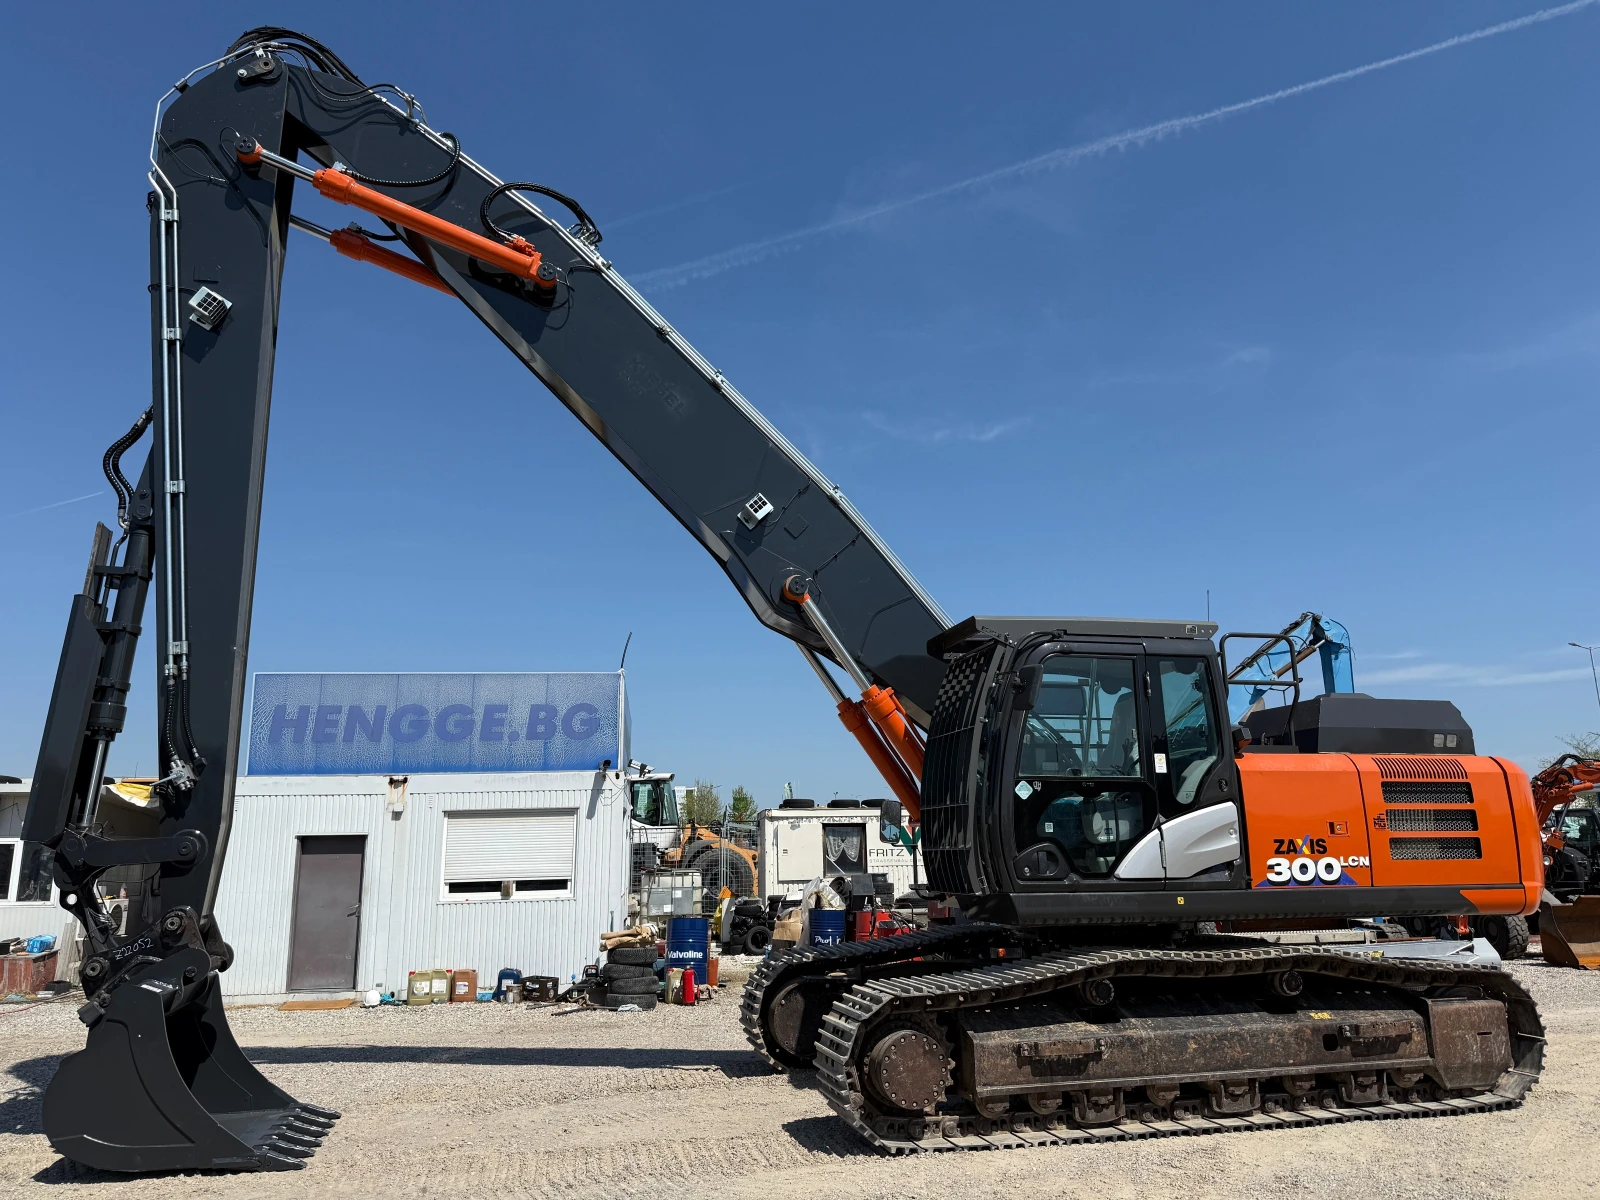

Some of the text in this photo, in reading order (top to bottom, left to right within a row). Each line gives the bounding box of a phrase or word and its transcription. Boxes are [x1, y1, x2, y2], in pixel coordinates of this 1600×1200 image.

[268, 703, 600, 744] HENGGE.BG
[869, 848, 904, 857] FRITZ
[1273, 834, 1328, 855] ZAXIS
[113, 938, 154, 960] Z22052
[667, 950, 703, 959] Valvoline
